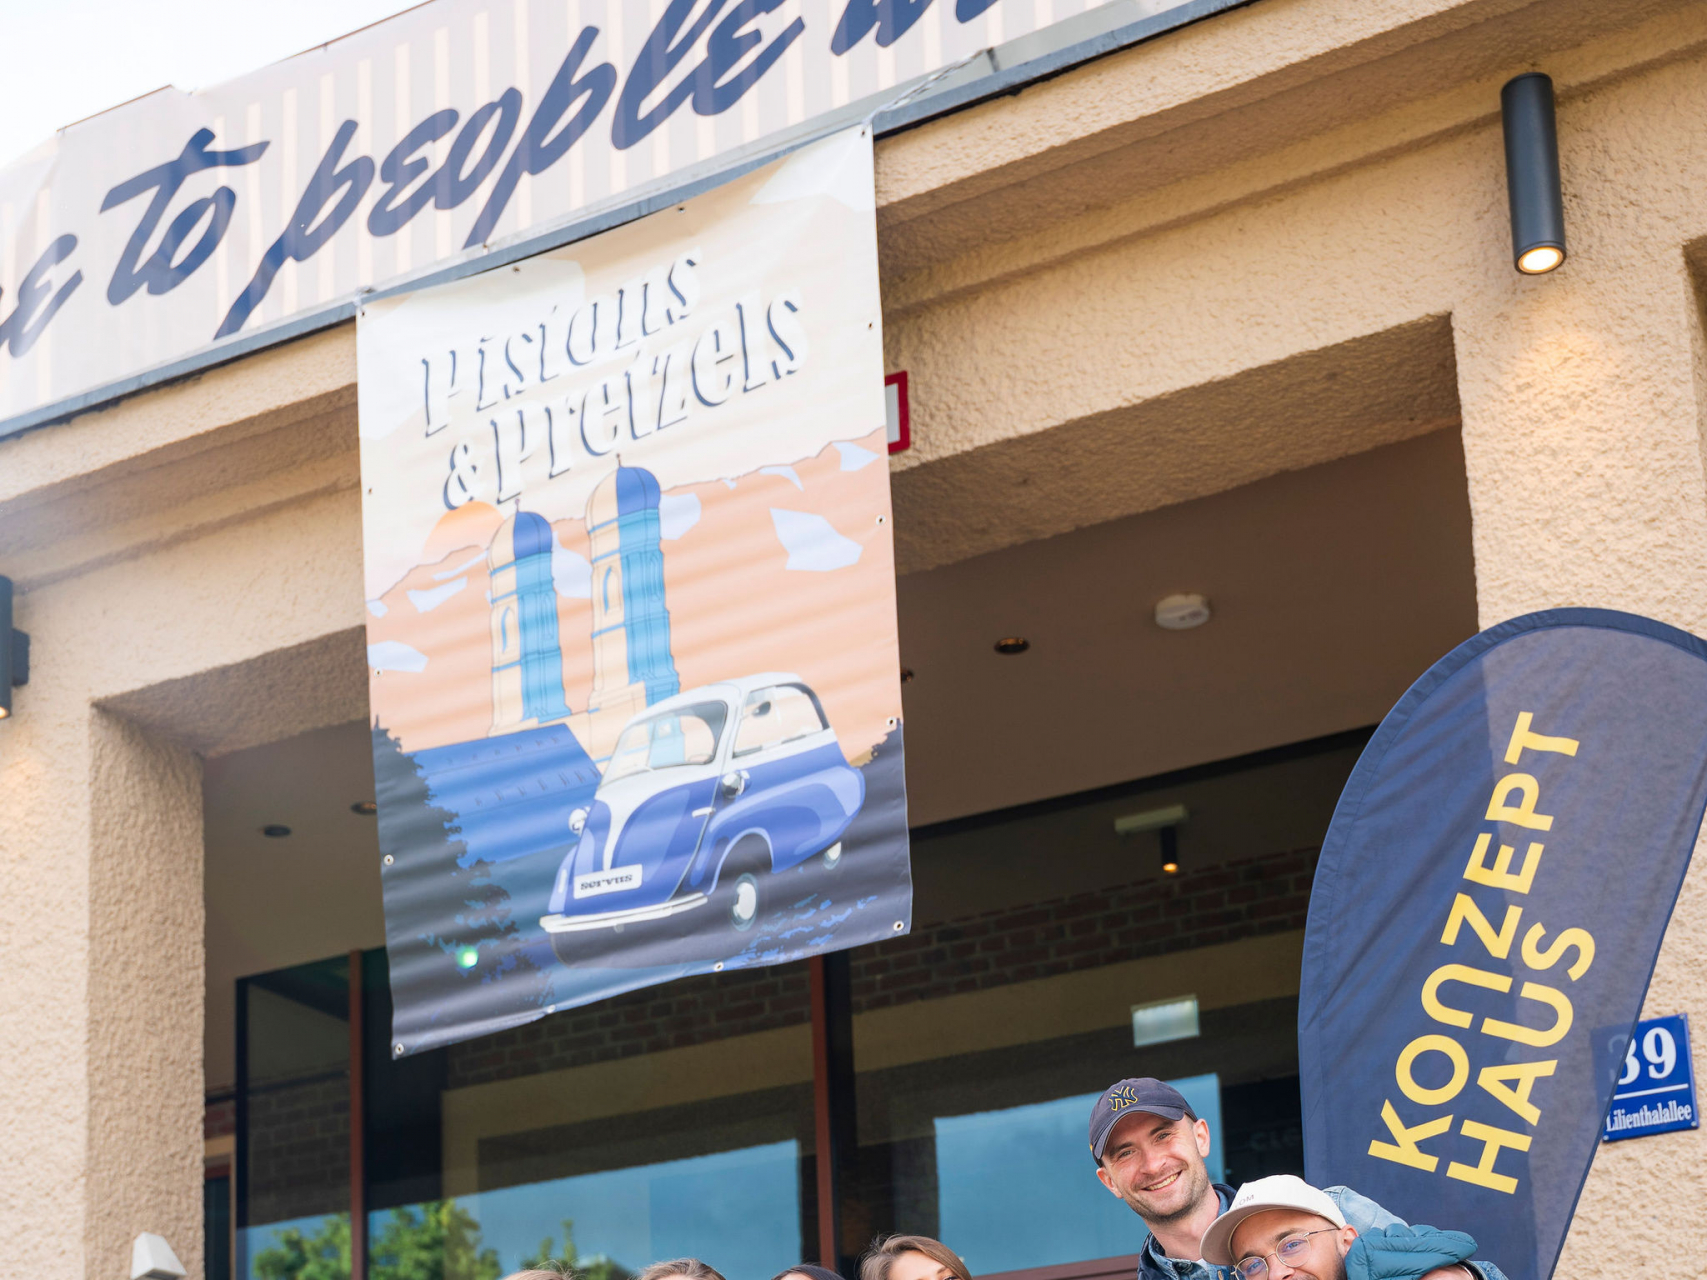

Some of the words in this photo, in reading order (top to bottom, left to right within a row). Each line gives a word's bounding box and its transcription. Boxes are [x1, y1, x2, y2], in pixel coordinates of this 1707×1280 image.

[99, 127, 271, 306] to
[213, 0, 806, 341] people
[442, 440, 486, 510] &
[1368, 711, 1579, 1172] KONZEPT
[1446, 922, 1595, 1194] HAUS
[1605, 1099, 1692, 1132] Lilienthalallee
[1608, 1026, 1677, 1085] 39
